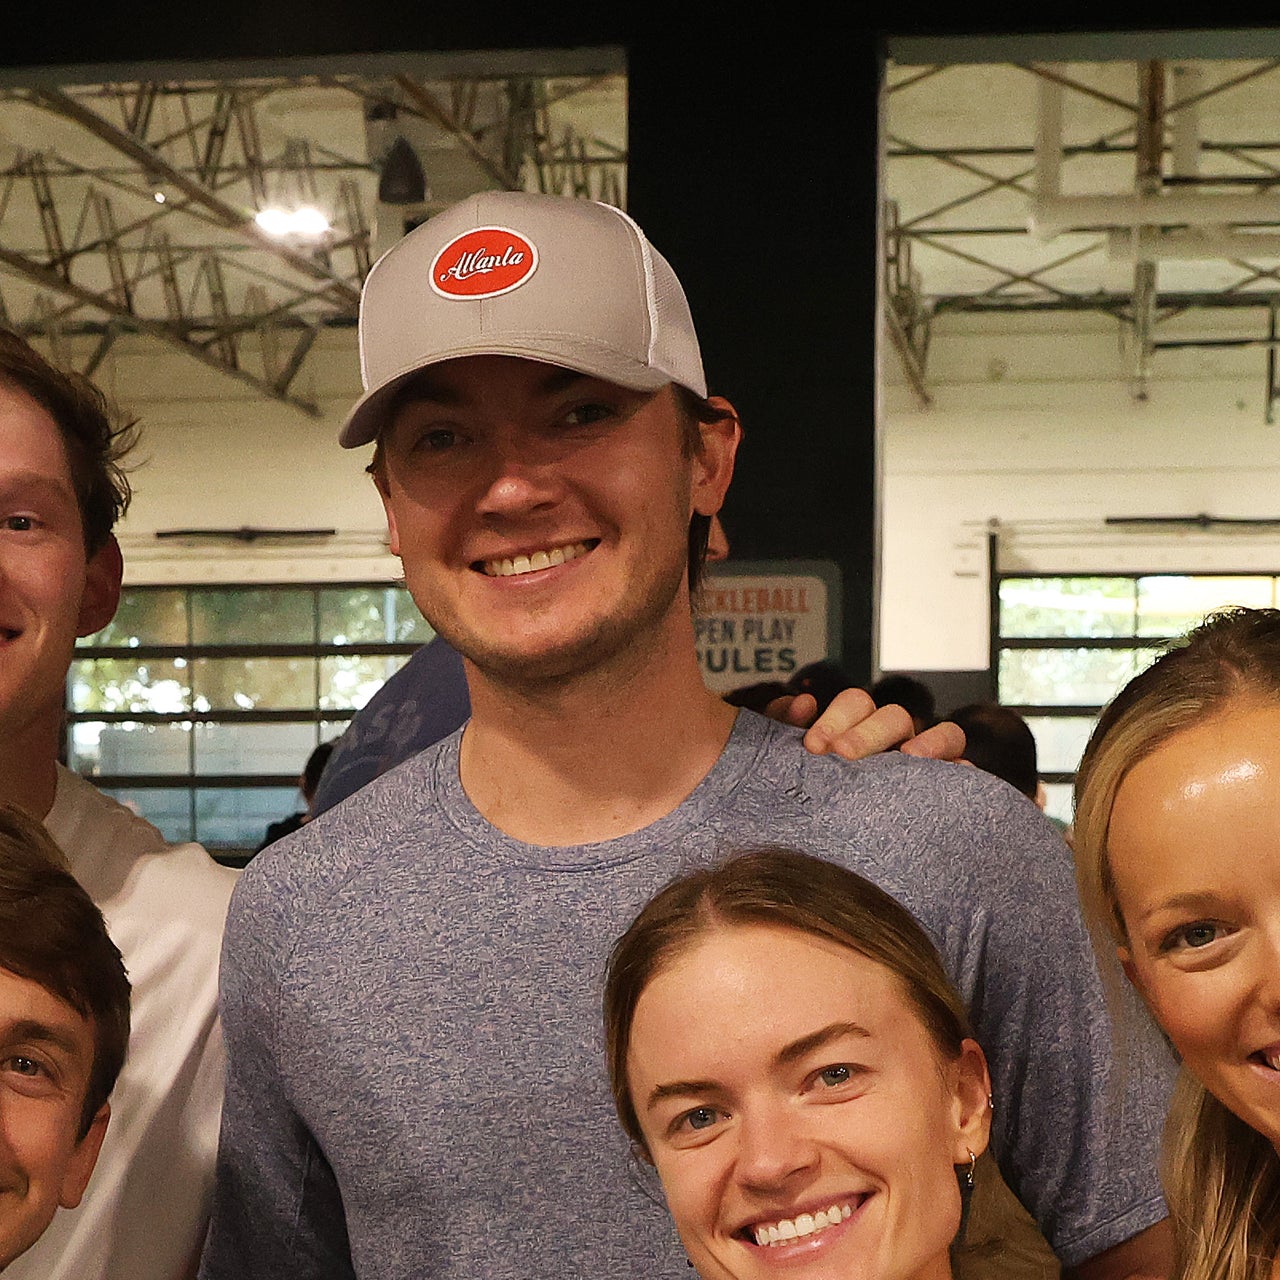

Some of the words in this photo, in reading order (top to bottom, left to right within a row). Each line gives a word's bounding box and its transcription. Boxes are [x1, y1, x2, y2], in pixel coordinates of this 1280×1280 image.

[440, 245, 524, 282] Atlanta
[695, 618, 735, 644] PEN
[743, 618, 796, 643] PLAY
